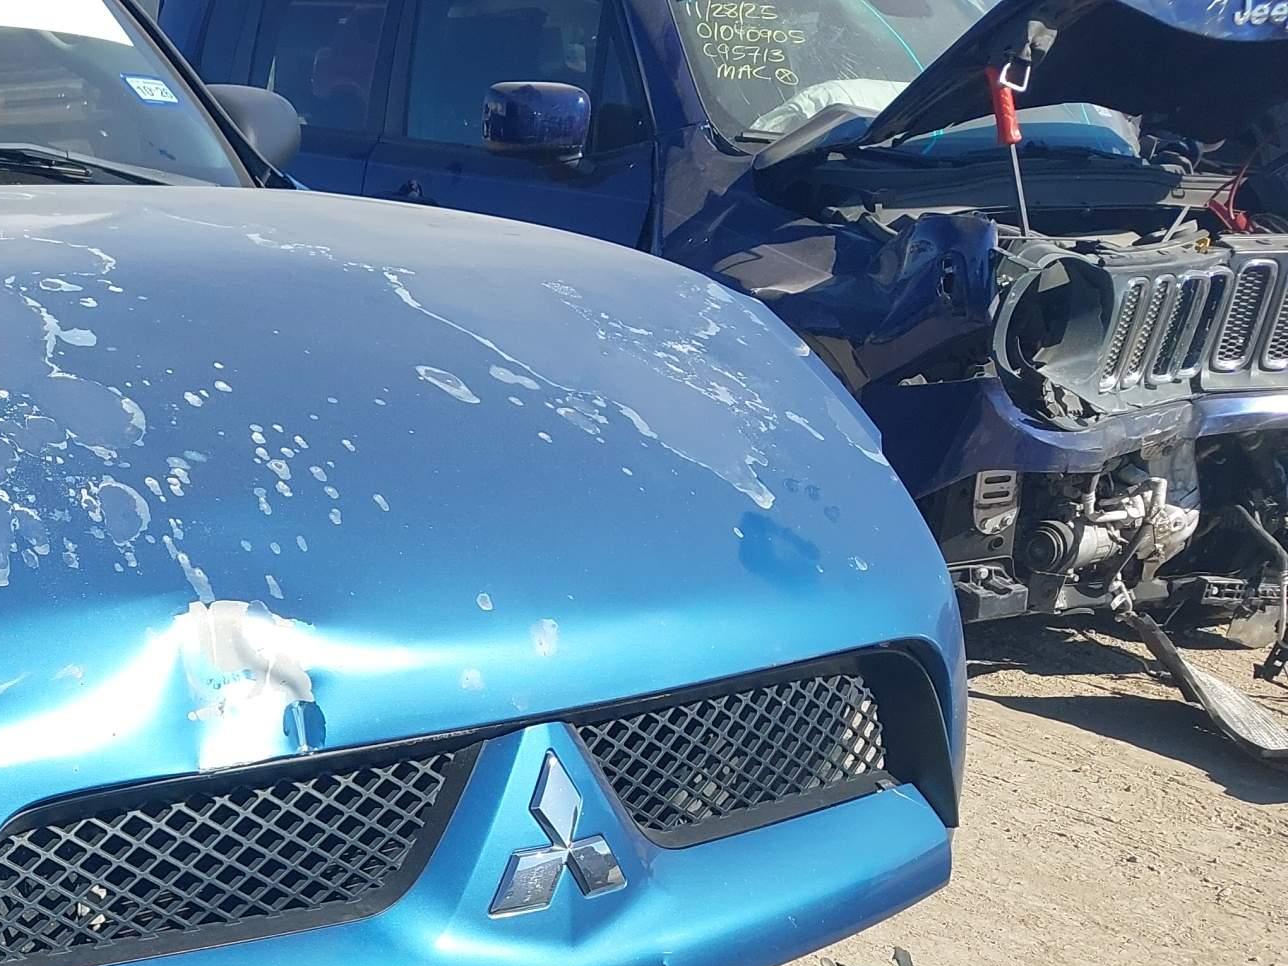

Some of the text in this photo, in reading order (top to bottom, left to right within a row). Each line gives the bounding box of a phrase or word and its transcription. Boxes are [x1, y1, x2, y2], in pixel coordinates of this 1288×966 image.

[696, 21, 806, 43] 01040905
[703, 43, 785, 63] C95713
[716, 64, 772, 81] MAC
